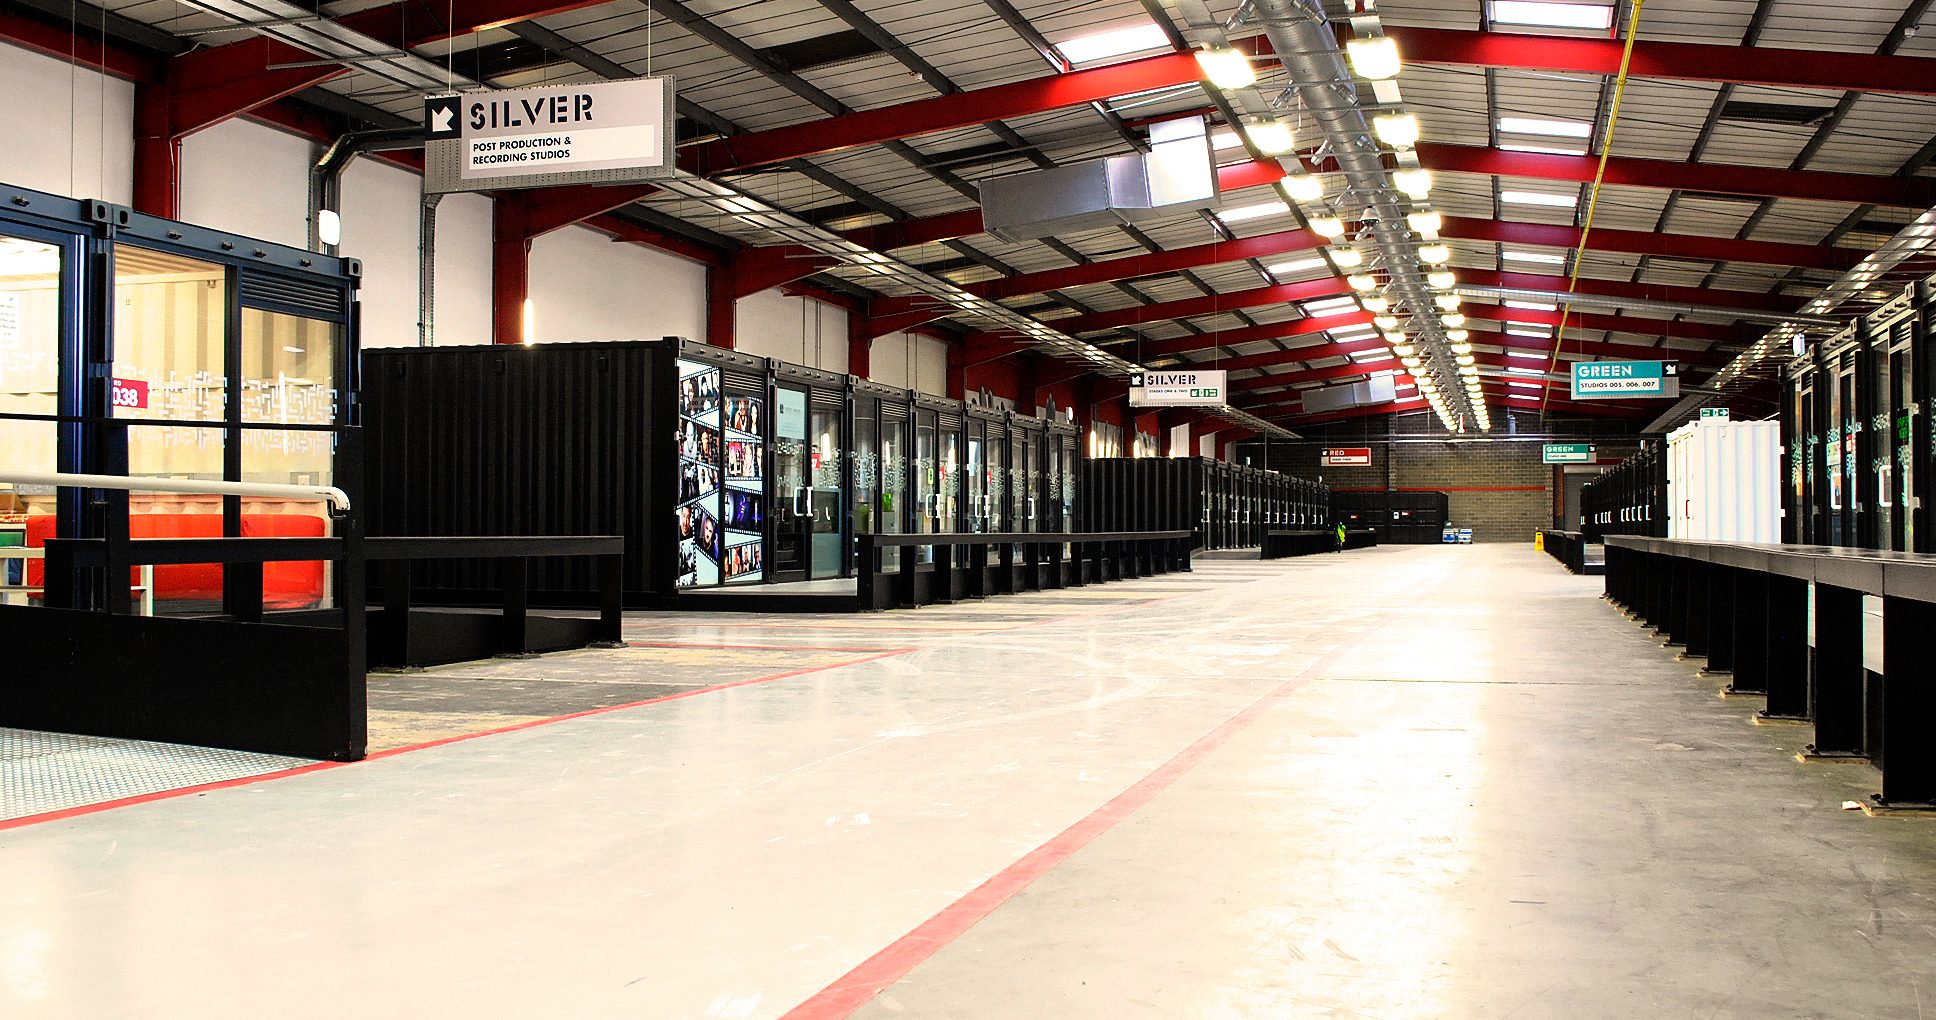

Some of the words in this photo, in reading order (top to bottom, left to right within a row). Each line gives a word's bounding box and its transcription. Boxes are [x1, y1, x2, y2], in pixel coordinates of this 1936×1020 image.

[470, 94, 593, 131] SILVER
[473, 142, 496, 152] POST
[499, 137, 561, 150] PRODUCTION
[564, 136, 571, 145] &
[473, 153, 528, 165] RECORDING
[530, 149, 570, 161] STUDIOS
[1578, 365, 1632, 377] GREEN
[1147, 374, 1197, 386] SILVER
[112, 386, 138, 407] 038
